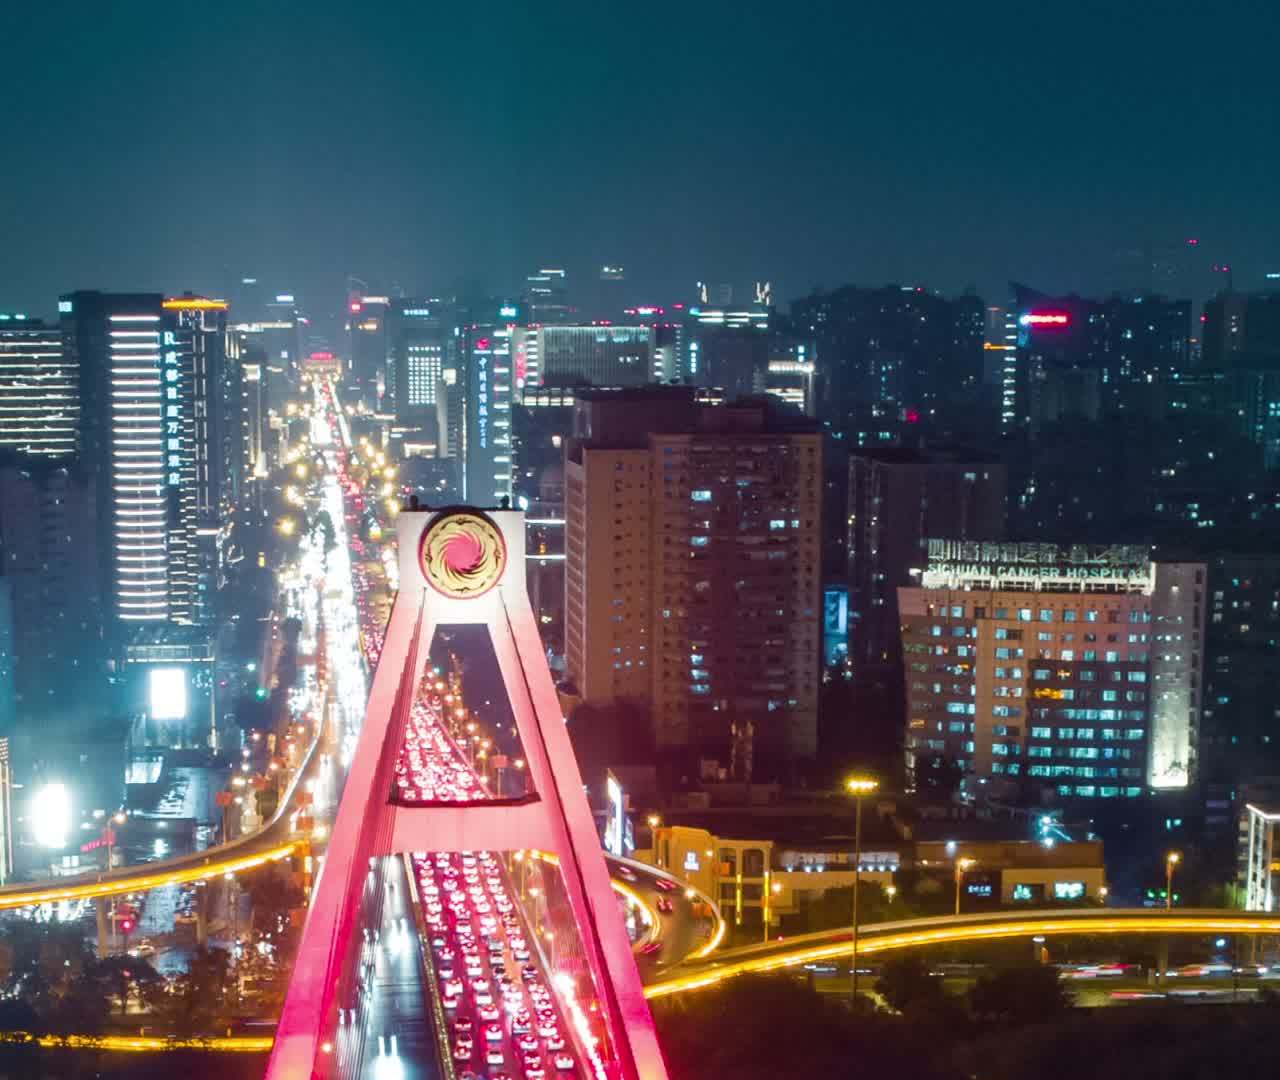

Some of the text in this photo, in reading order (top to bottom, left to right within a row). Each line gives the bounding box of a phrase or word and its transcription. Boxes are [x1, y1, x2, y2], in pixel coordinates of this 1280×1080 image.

[928, 563, 1147, 579] SICHUAN CANCER HOSPITAL
